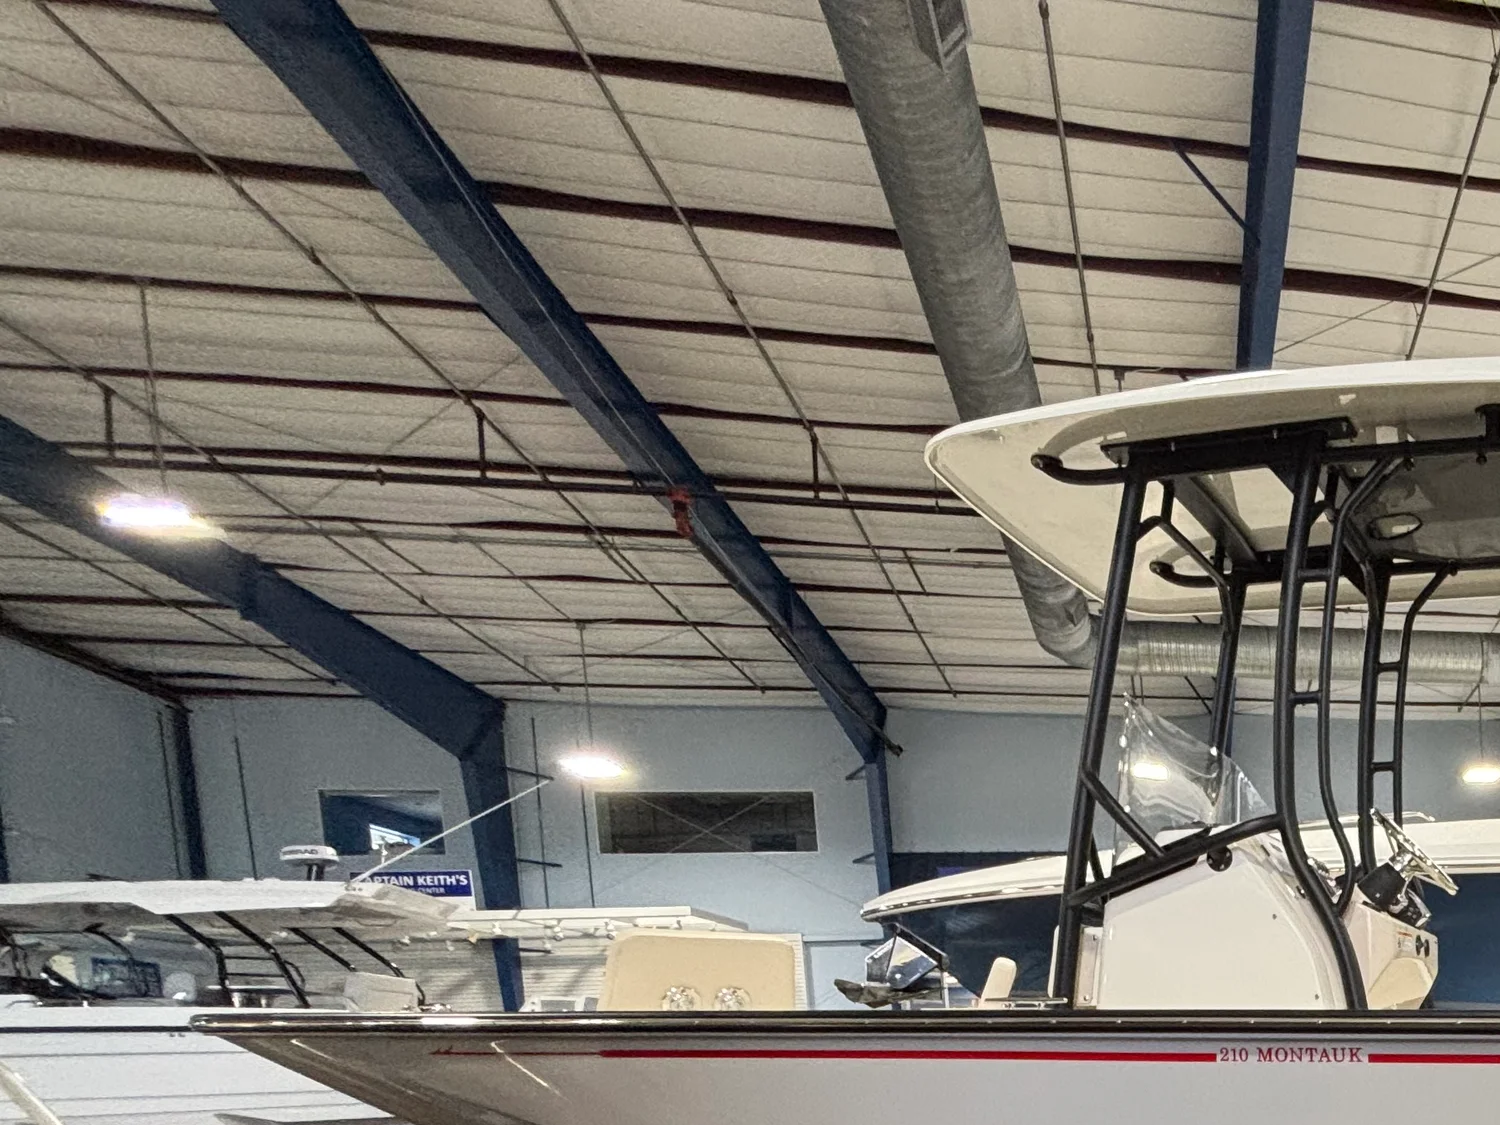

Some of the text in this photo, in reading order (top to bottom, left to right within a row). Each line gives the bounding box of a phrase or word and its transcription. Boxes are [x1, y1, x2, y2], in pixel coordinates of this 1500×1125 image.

[416, 875, 468, 886] KEITH'S
[1219, 1047, 1363, 1063] 210 MONTAUK
